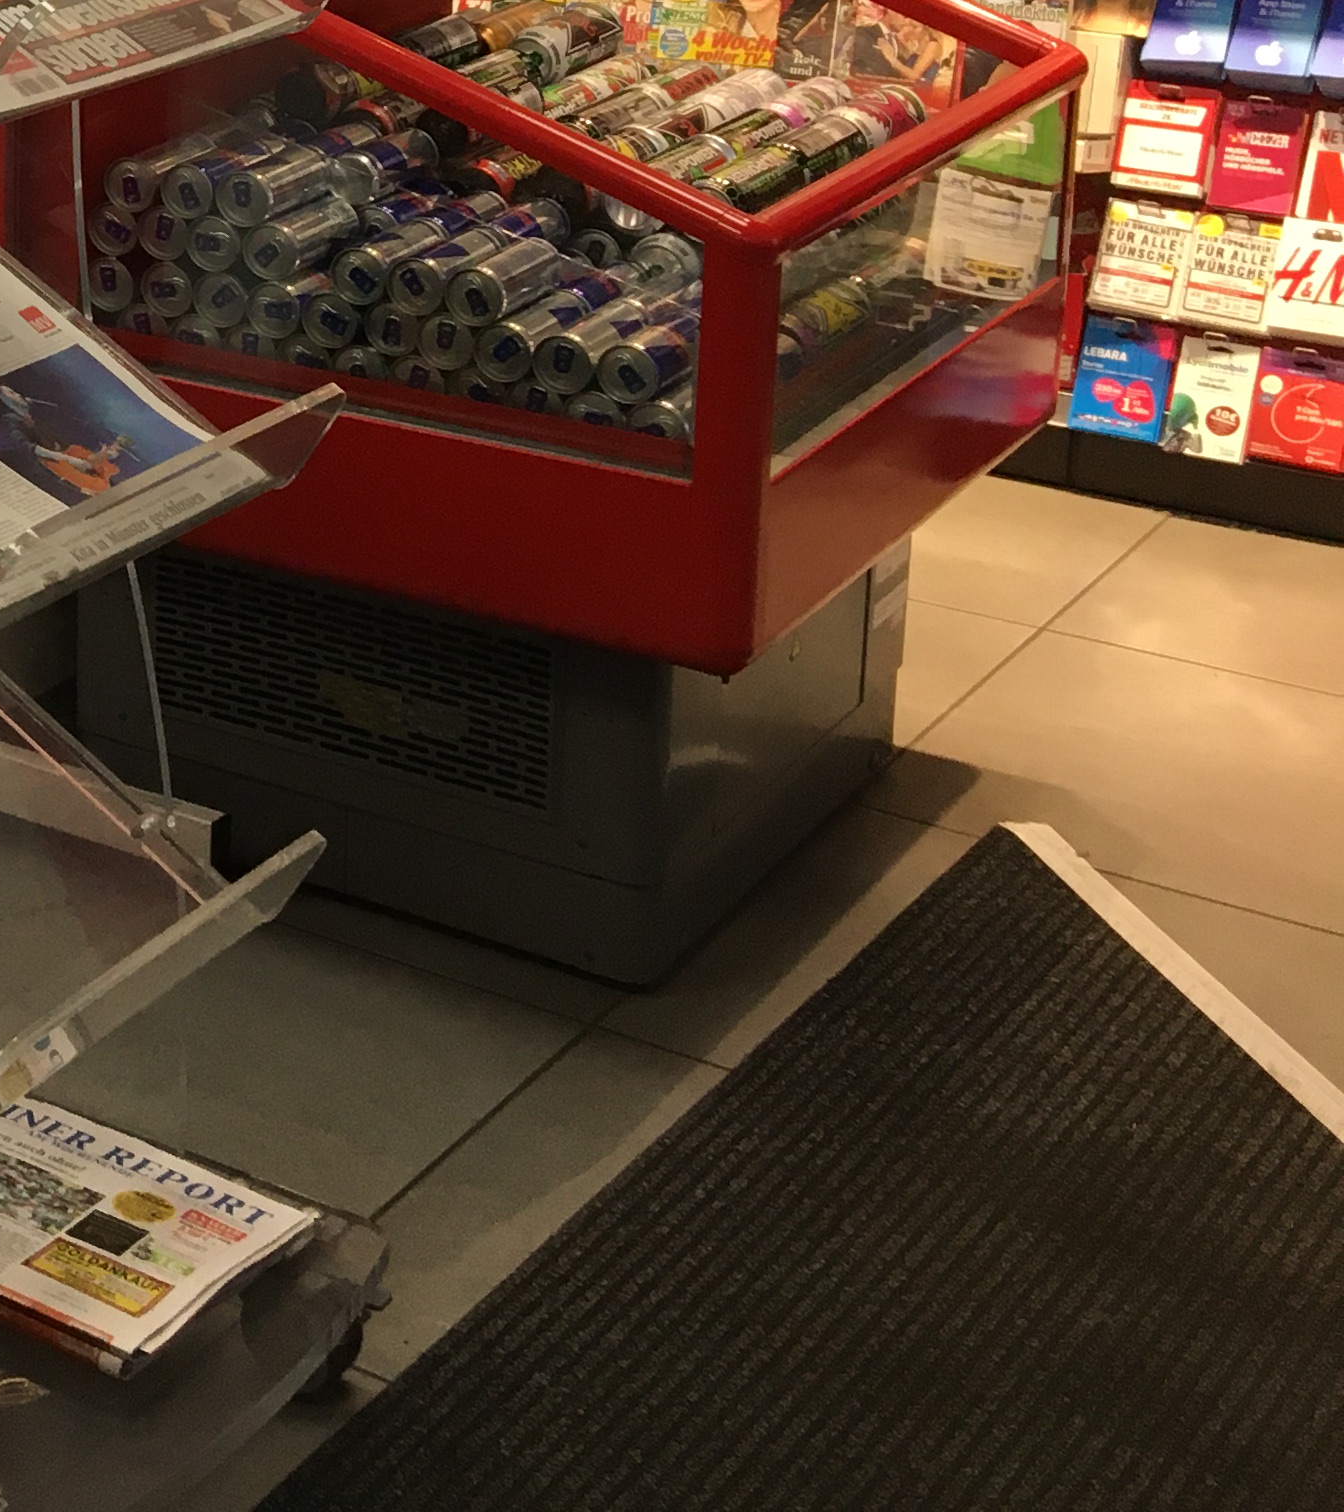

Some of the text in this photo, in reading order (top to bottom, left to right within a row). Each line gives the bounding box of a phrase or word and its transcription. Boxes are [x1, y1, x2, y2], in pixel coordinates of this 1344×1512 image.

[1107, 227, 1138, 244] FÜR
[1140, 233, 1178, 252] ALLE
[1105, 242, 1176, 264] WÜNSCHE
[1196, 243, 1225, 259] FÜR
[1230, 250, 1268, 267] ALLE
[1193, 257, 1267, 280] WÜNSCHE
[1083, 346, 1128, 362] LEBARA
[148, 492, 207, 531] geschlossen
[103, 1144, 275, 1227] REPORT
